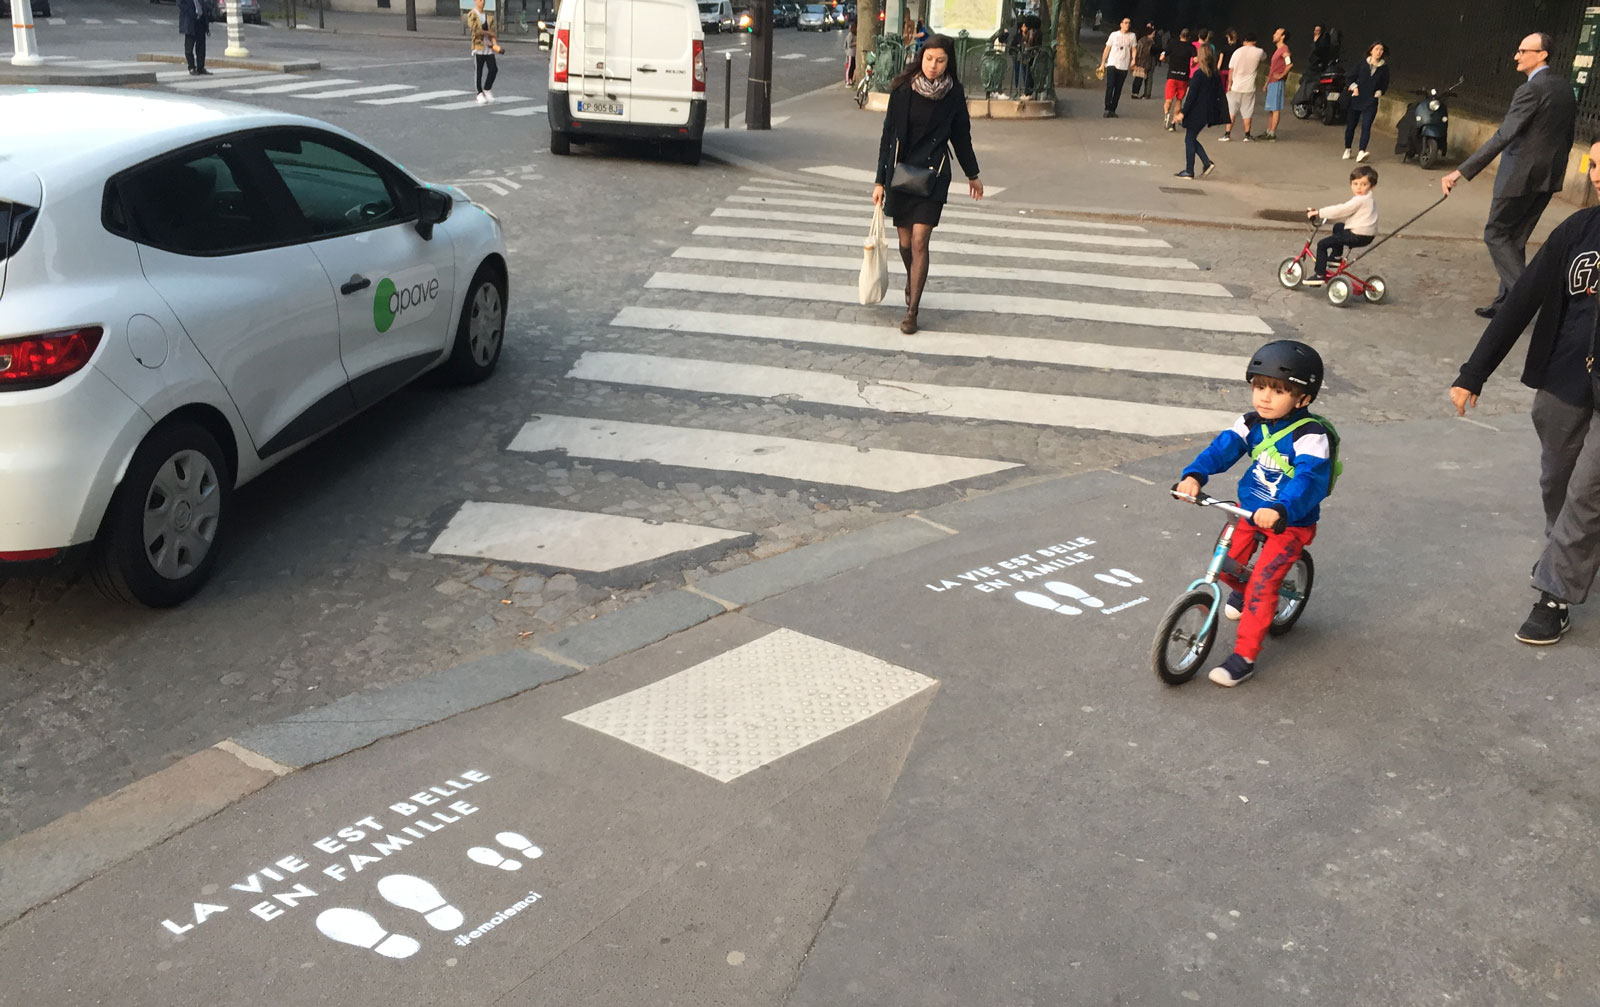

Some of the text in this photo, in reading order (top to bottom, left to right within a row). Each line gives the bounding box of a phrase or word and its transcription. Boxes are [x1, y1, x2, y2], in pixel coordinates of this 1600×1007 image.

[582, 102, 592, 111] CP
[593, 103, 607, 113] 905
[389, 278, 440, 315] apave
[925, 536, 1097, 592] LA VIE EST BELLE
[973, 551, 1095, 593] EN FAMILLE
[160, 769, 492, 935] LA VIE EST BELLE
[249, 800, 480, 922] EN FAMILLE
[454, 890, 543, 947] #emoiemoi
